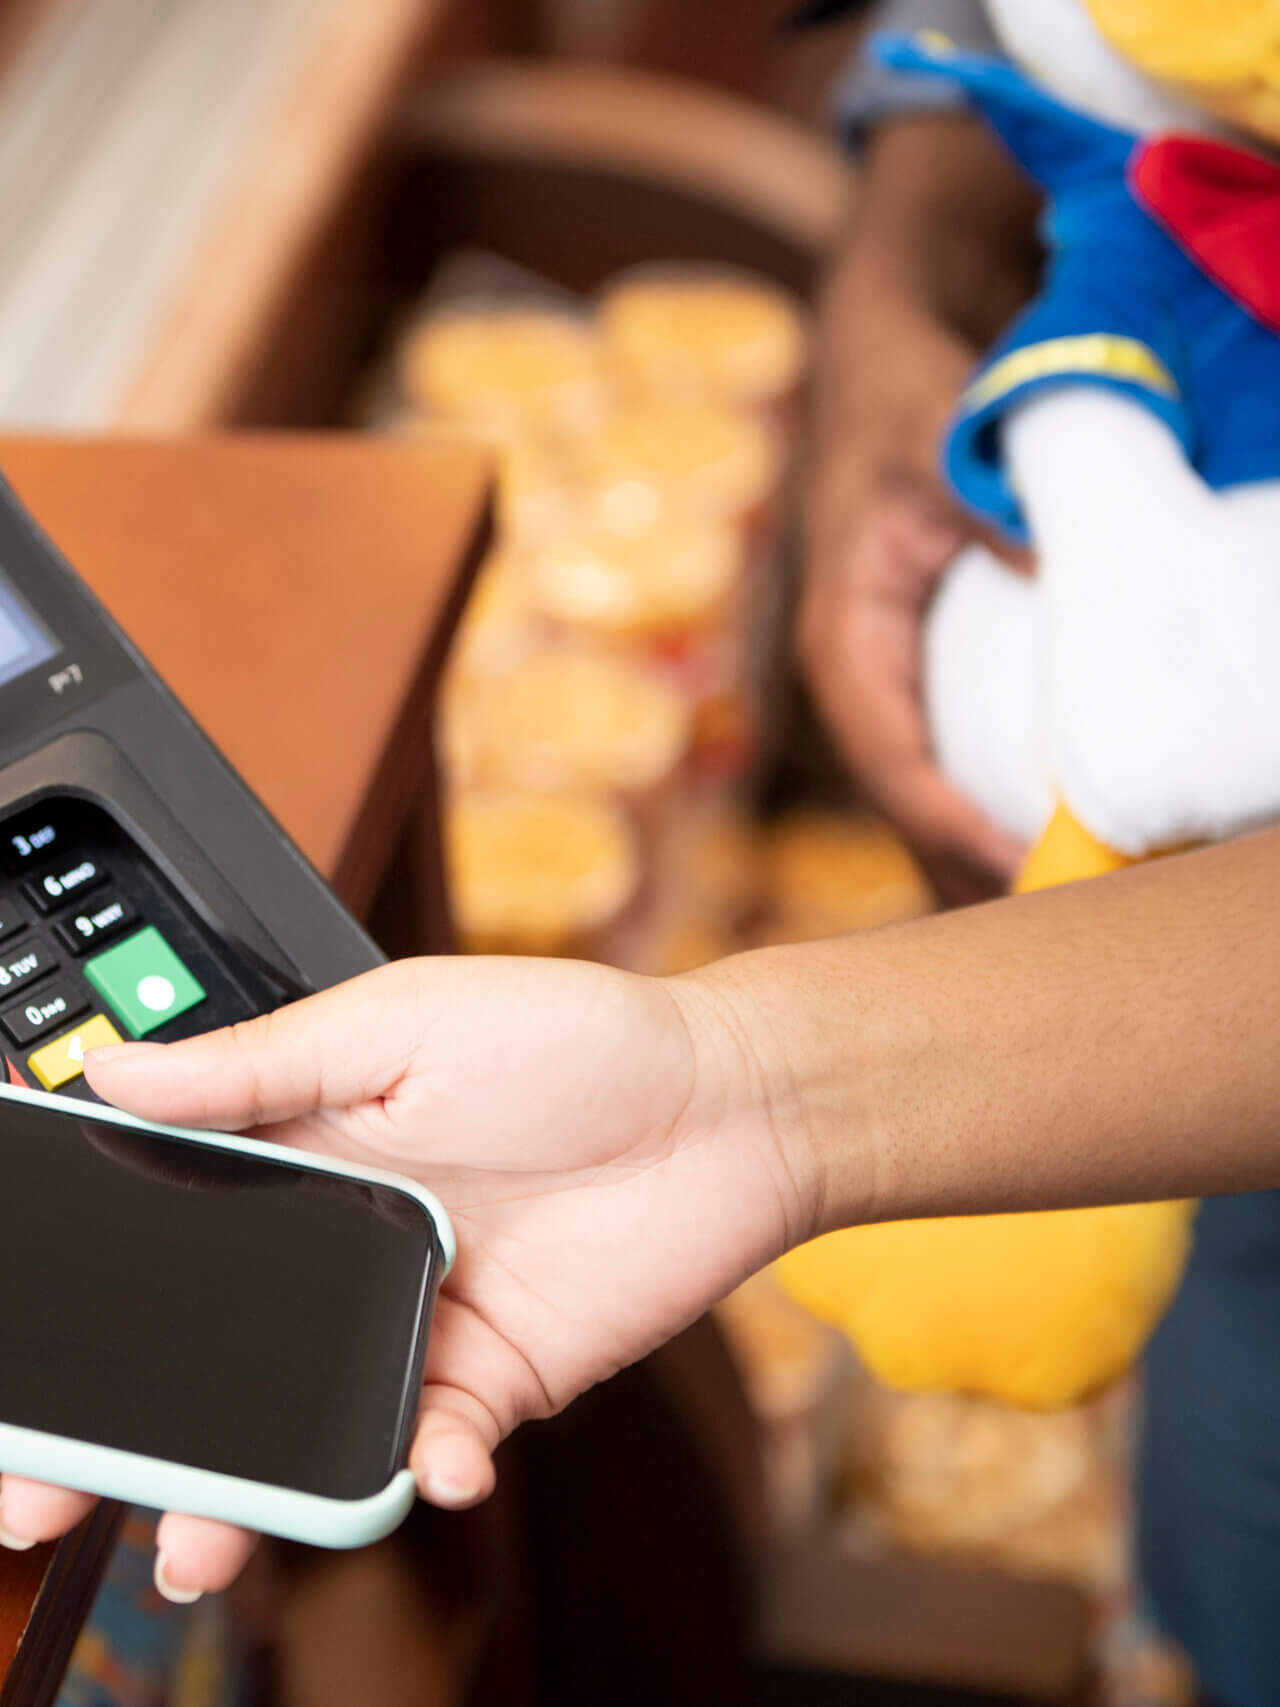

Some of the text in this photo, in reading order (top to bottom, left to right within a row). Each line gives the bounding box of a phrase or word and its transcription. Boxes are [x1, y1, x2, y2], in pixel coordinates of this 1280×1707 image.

[12, 835, 32, 856] 3
[43, 875, 63, 897] 6
[75, 915, 95, 937] 9
[9, 953, 39, 979] TUV
[25, 1005, 44, 1026] 0
